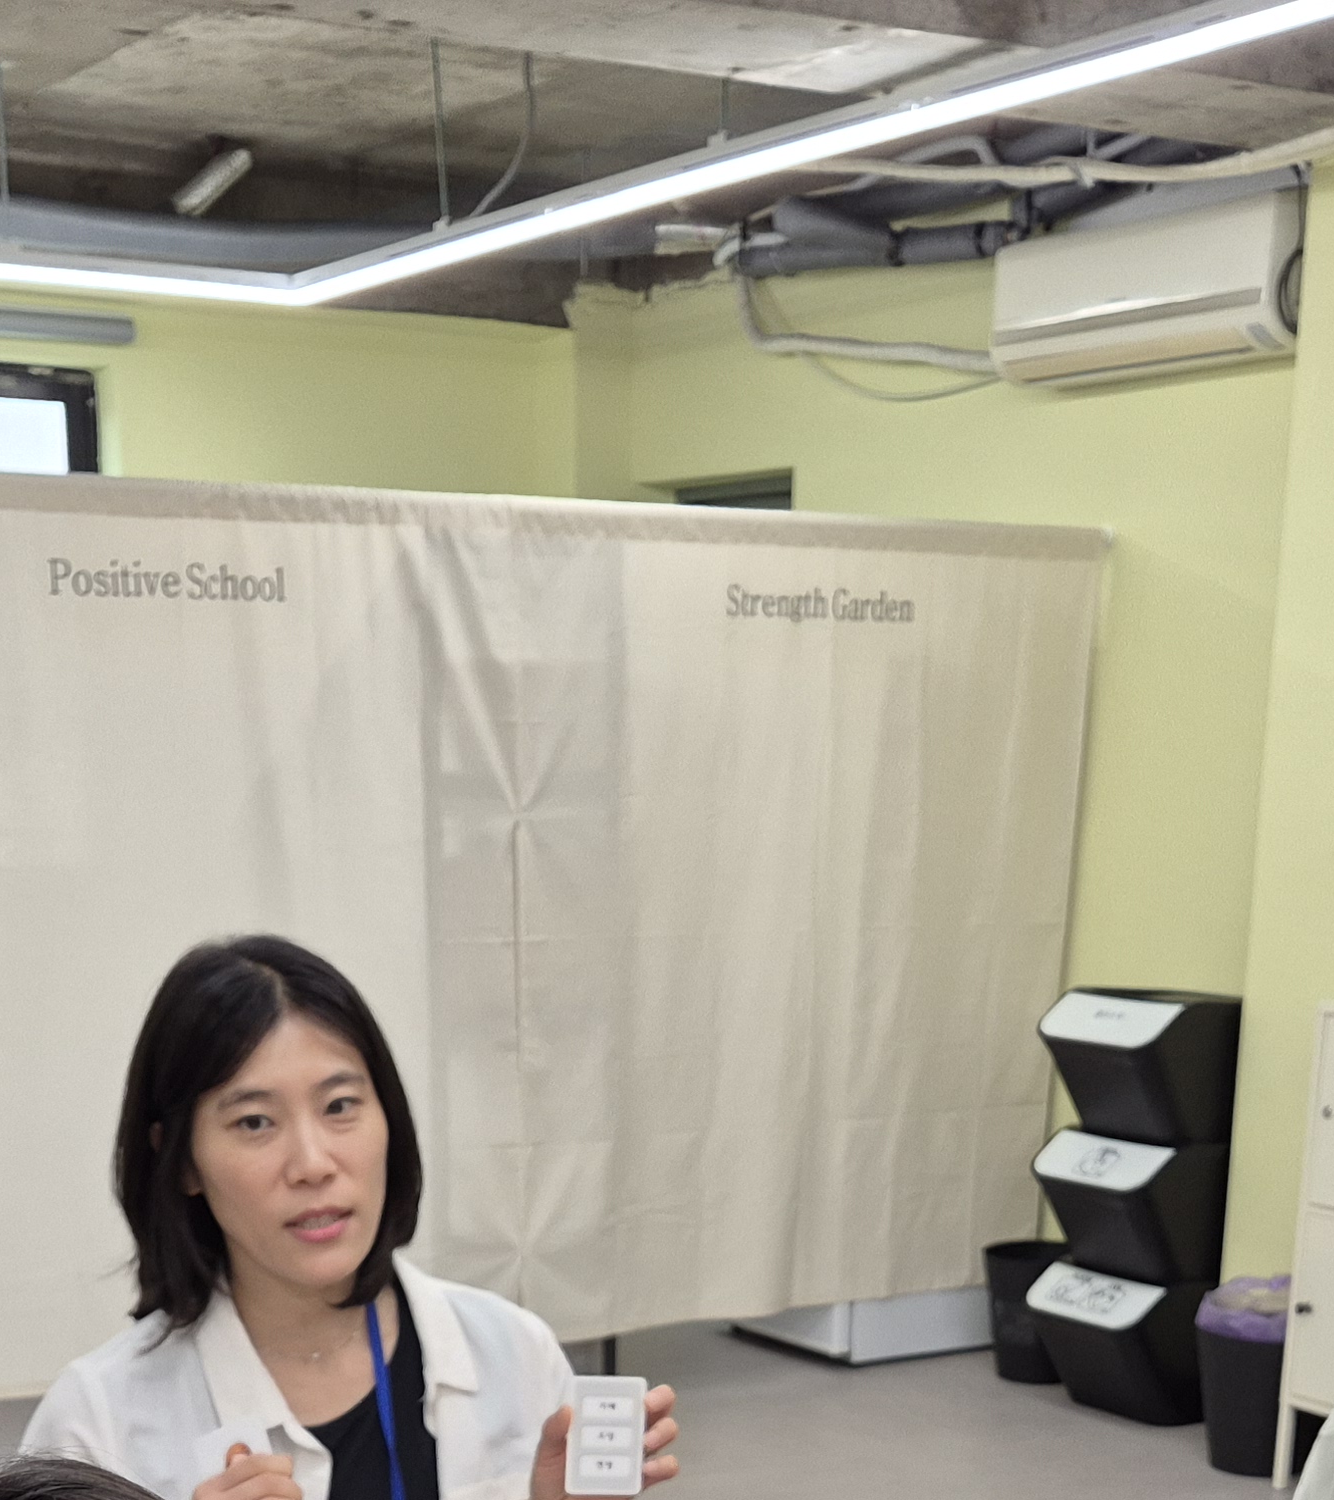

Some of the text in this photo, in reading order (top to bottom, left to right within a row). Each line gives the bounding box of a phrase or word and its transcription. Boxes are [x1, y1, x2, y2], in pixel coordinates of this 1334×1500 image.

[47, 557, 286, 602] Positive School
[726, 583, 916, 623] Strength Garden
